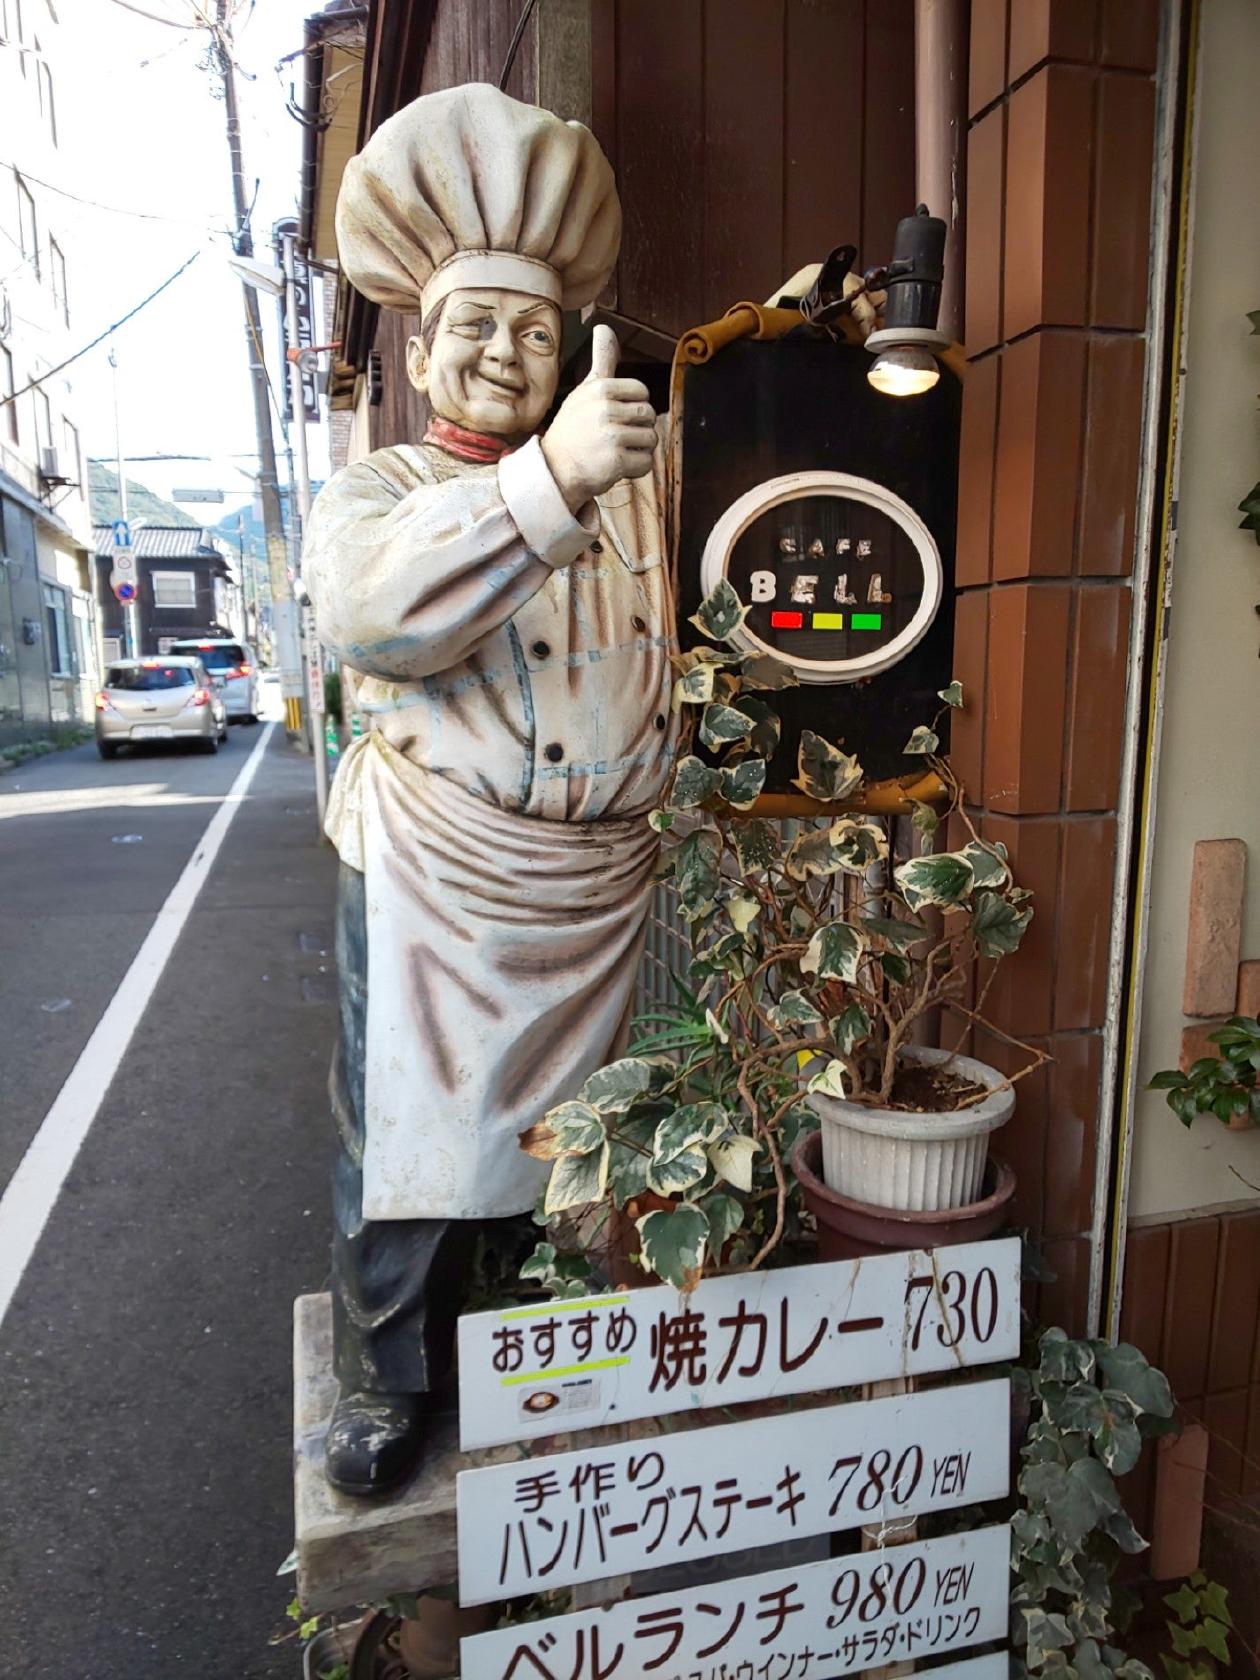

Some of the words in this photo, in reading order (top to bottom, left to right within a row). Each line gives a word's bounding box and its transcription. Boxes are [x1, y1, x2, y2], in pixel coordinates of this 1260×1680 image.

[750, 570, 892, 604] BELL
[779, 538, 872, 559] CAFE
[492, 1306, 637, 1372] おすすめ
[648, 1296, 884, 1393] 焼カレー
[904, 1267, 998, 1351] 730
[500, 1465, 805, 1585] ハンバーグステーキ
[828, 1445, 923, 1516] 780
[931, 1451, 971, 1498] YEN
[514, 1452, 664, 1513] 手作り
[502, 1583, 804, 1680] ベルランチ
[826, 1557, 926, 1629] 980
[934, 1562, 975, 1607] YEN
